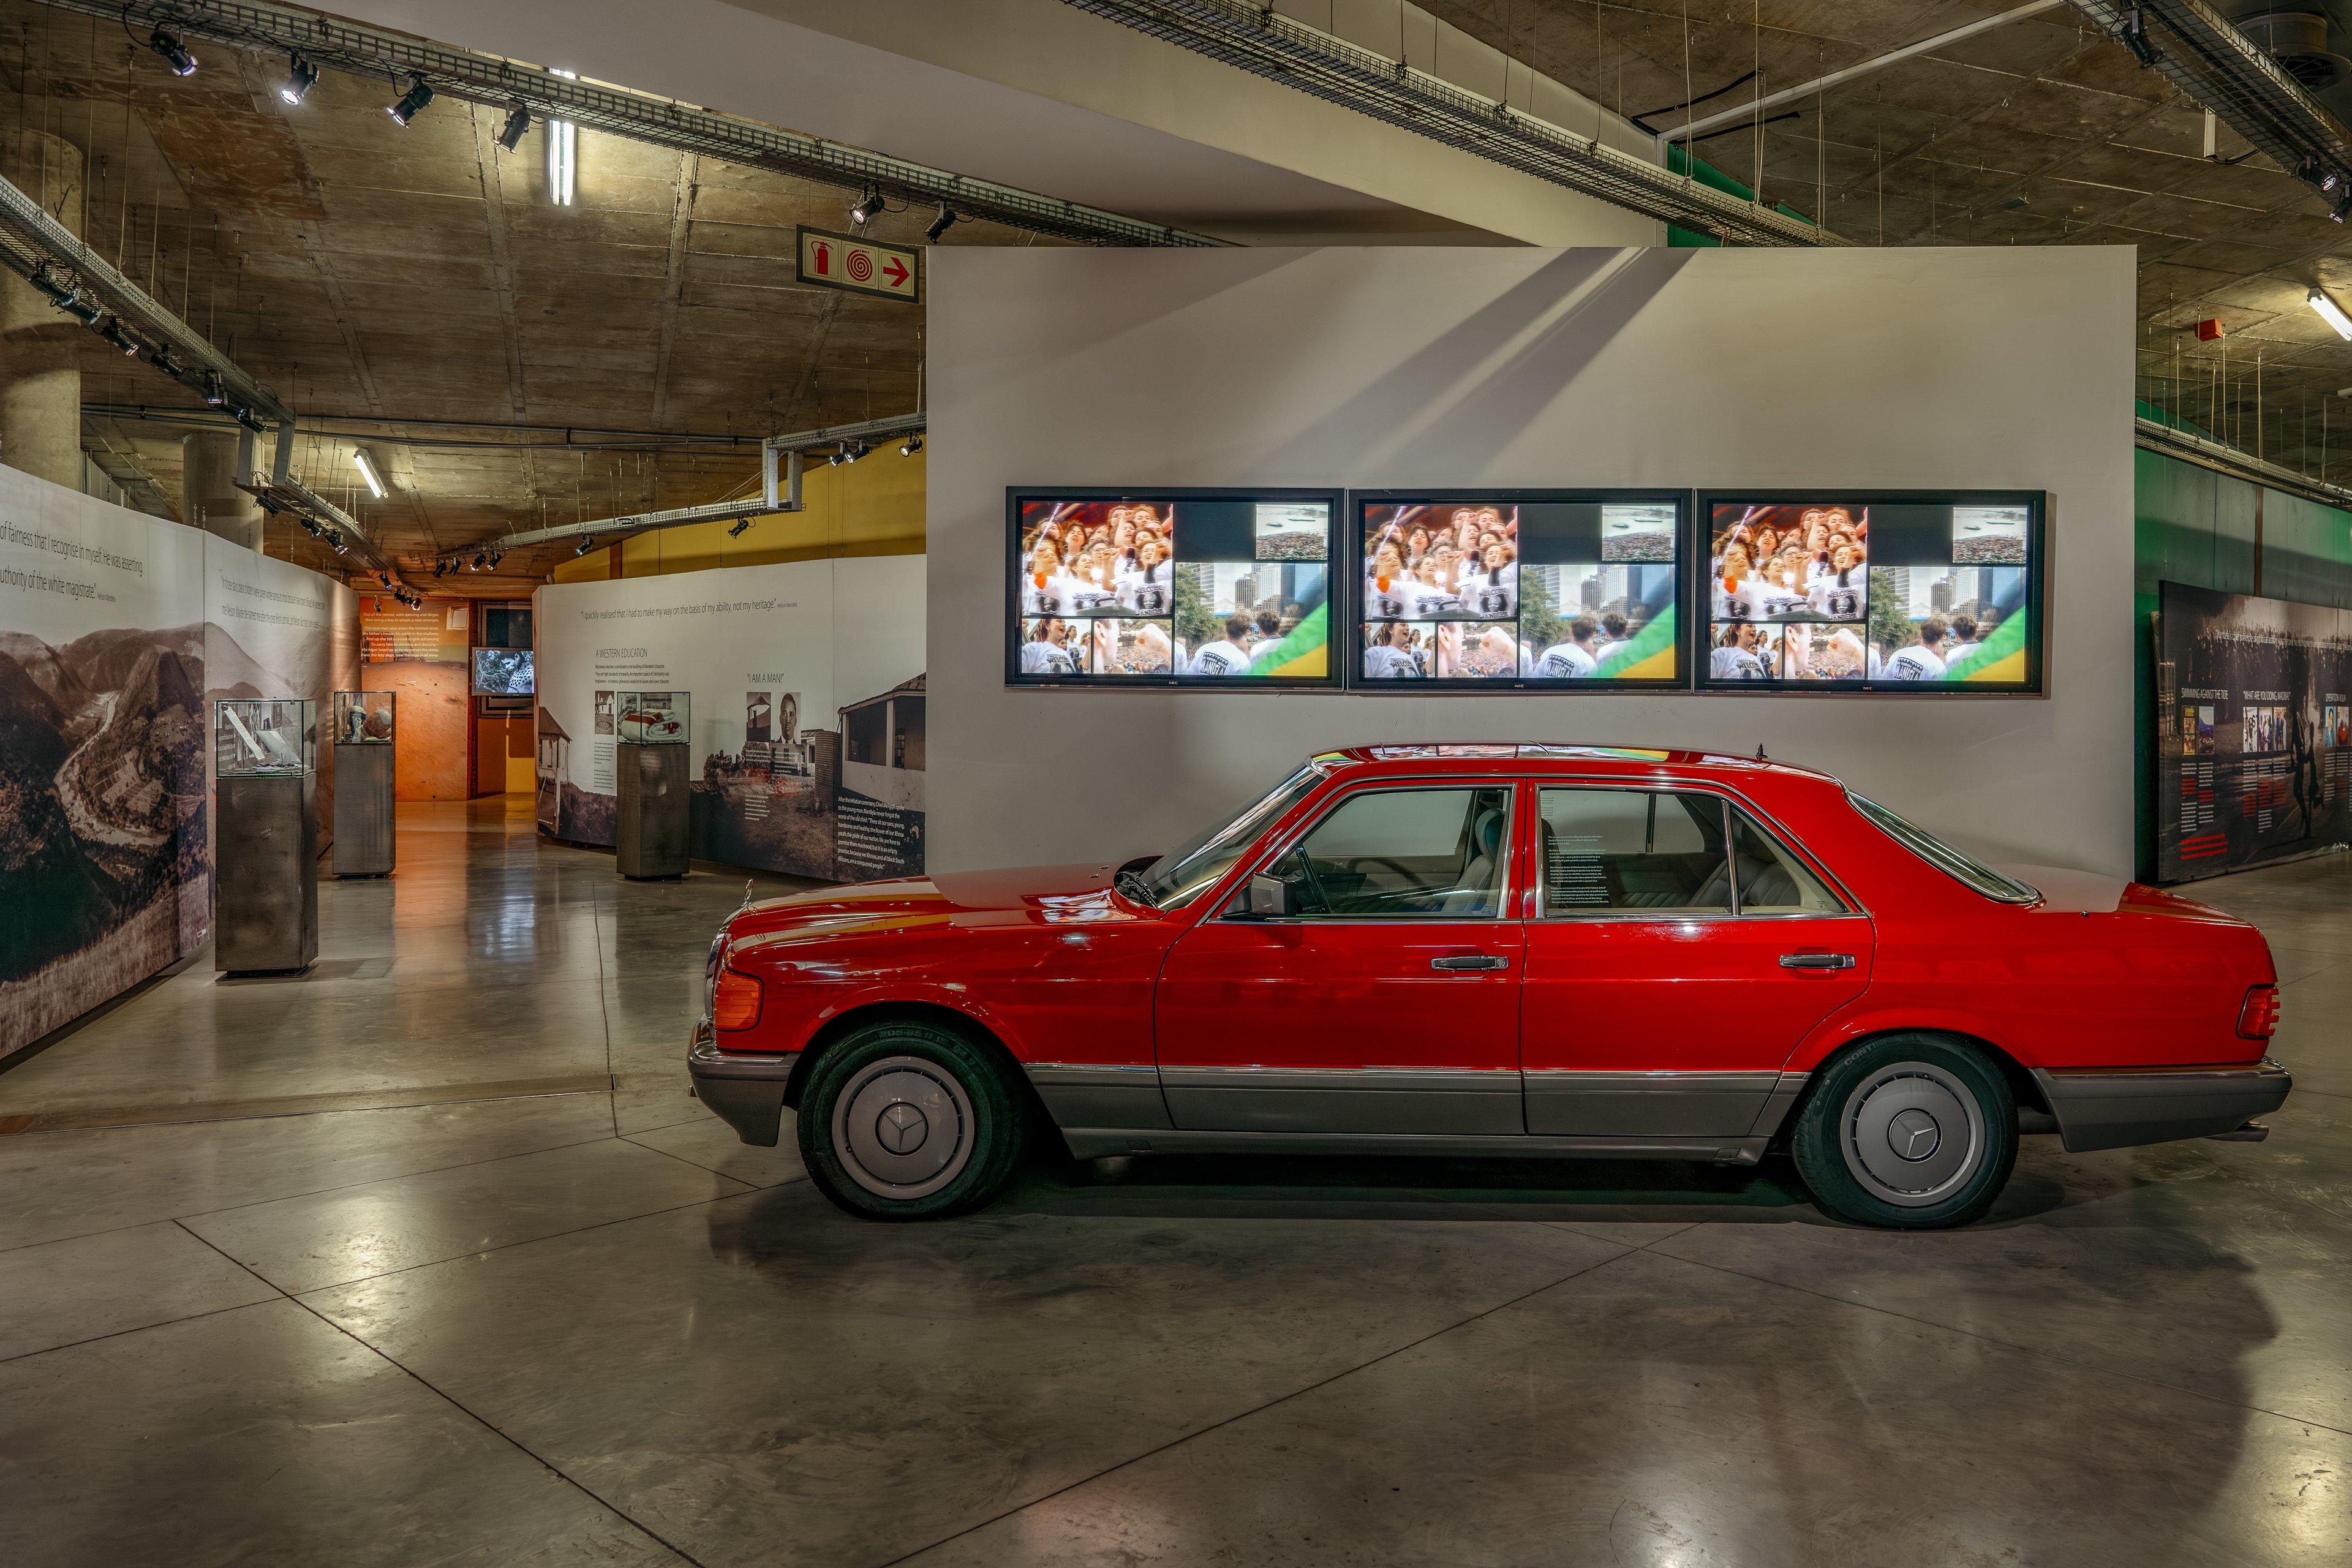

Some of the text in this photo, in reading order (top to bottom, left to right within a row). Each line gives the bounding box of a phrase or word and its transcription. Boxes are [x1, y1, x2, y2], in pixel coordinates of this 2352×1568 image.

[0, 521, 8, 540] of
[9, 522, 33, 547] fairness
[34, 530, 47, 550] that
[51, 539, 78, 560] recognise
[79, 543, 85, 559] in
[86, 545, 103, 567] myself.
[103, 549, 110, 565] He
[111, 555, 121, 568] was
[121, 557, 143, 577] asserting
[0, 564, 28, 592] uthority
[28, 570, 36, 589] of
[37, 571, 47, 590] the
[48, 574, 65, 594] white
[584, 611, 599, 622] quickly
[600, 609, 616, 619] realised
[616, 609, 625, 618] that
[628, 608, 637, 617] had
[643, 607, 655, 617] make
[655, 609, 663, 618] my
[663, 608, 673, 617] way
[680, 605, 688, 614] the
[689, 604, 701, 614] basis
[701, 602, 707, 612] of
[707, 605, 715, 614] my
[716, 601, 732, 613] ability,
[733, 602, 742, 611] not
[742, 603, 752, 612] my
[595, 648, 647, 658] A WESTERN EDUCATION
[752, 673, 761, 683] AM
[762, 673, 766, 683] A
[2200, 689, 2214, 699] AGAINST
